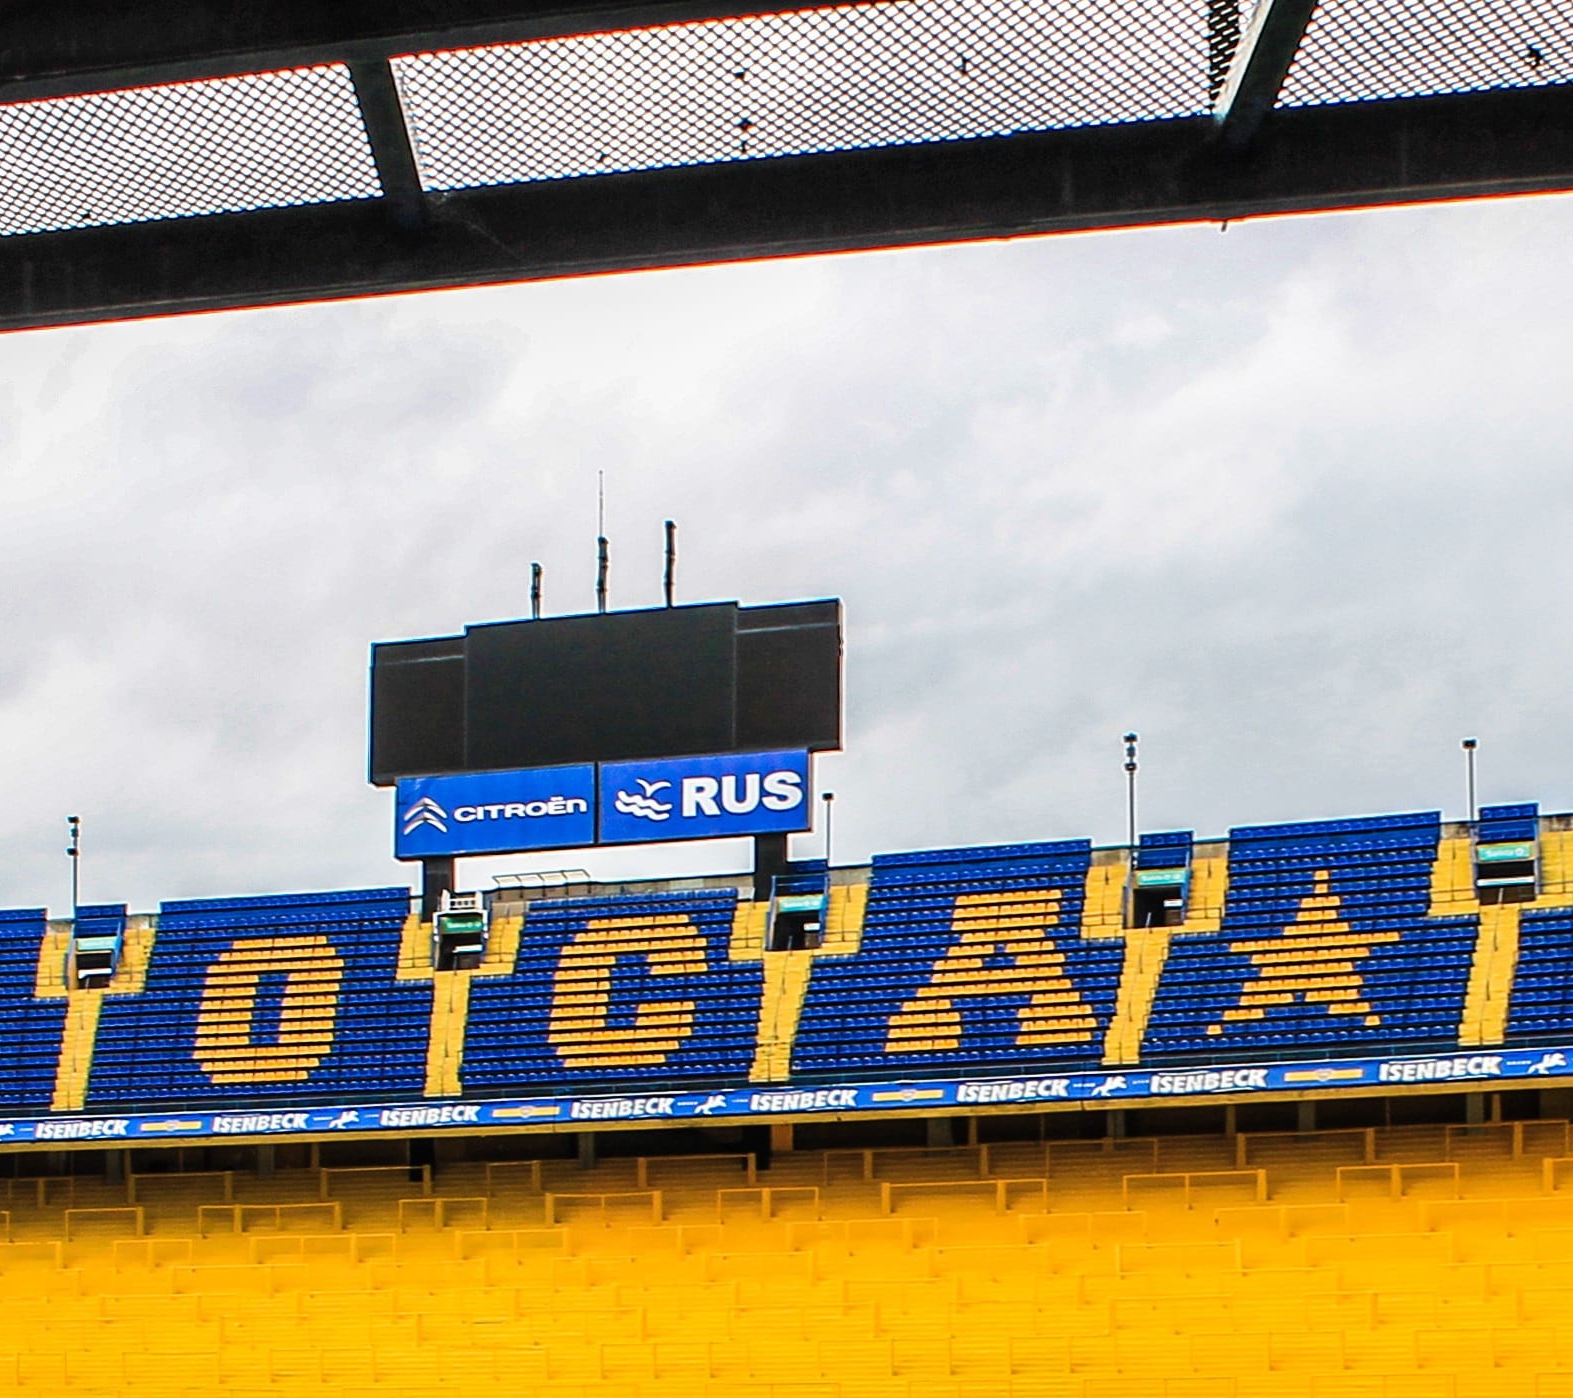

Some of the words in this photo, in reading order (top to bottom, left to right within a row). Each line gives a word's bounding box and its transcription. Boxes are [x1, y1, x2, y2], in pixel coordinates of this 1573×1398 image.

[681, 771, 802, 817] RUS
[1379, 1054, 1504, 1080] ISENBECK
[956, 1079, 1071, 1102] ISENBECK
[1150, 1068, 1269, 1093] ISENBECK
[570, 1097, 675, 1119] ISENBECK
[750, 1089, 858, 1112] ISENBECK
[212, 1112, 310, 1133] ISENBECK
[381, 1105, 482, 1127] ISENBECK
[35, 1119, 130, 1139] ISENBECK
